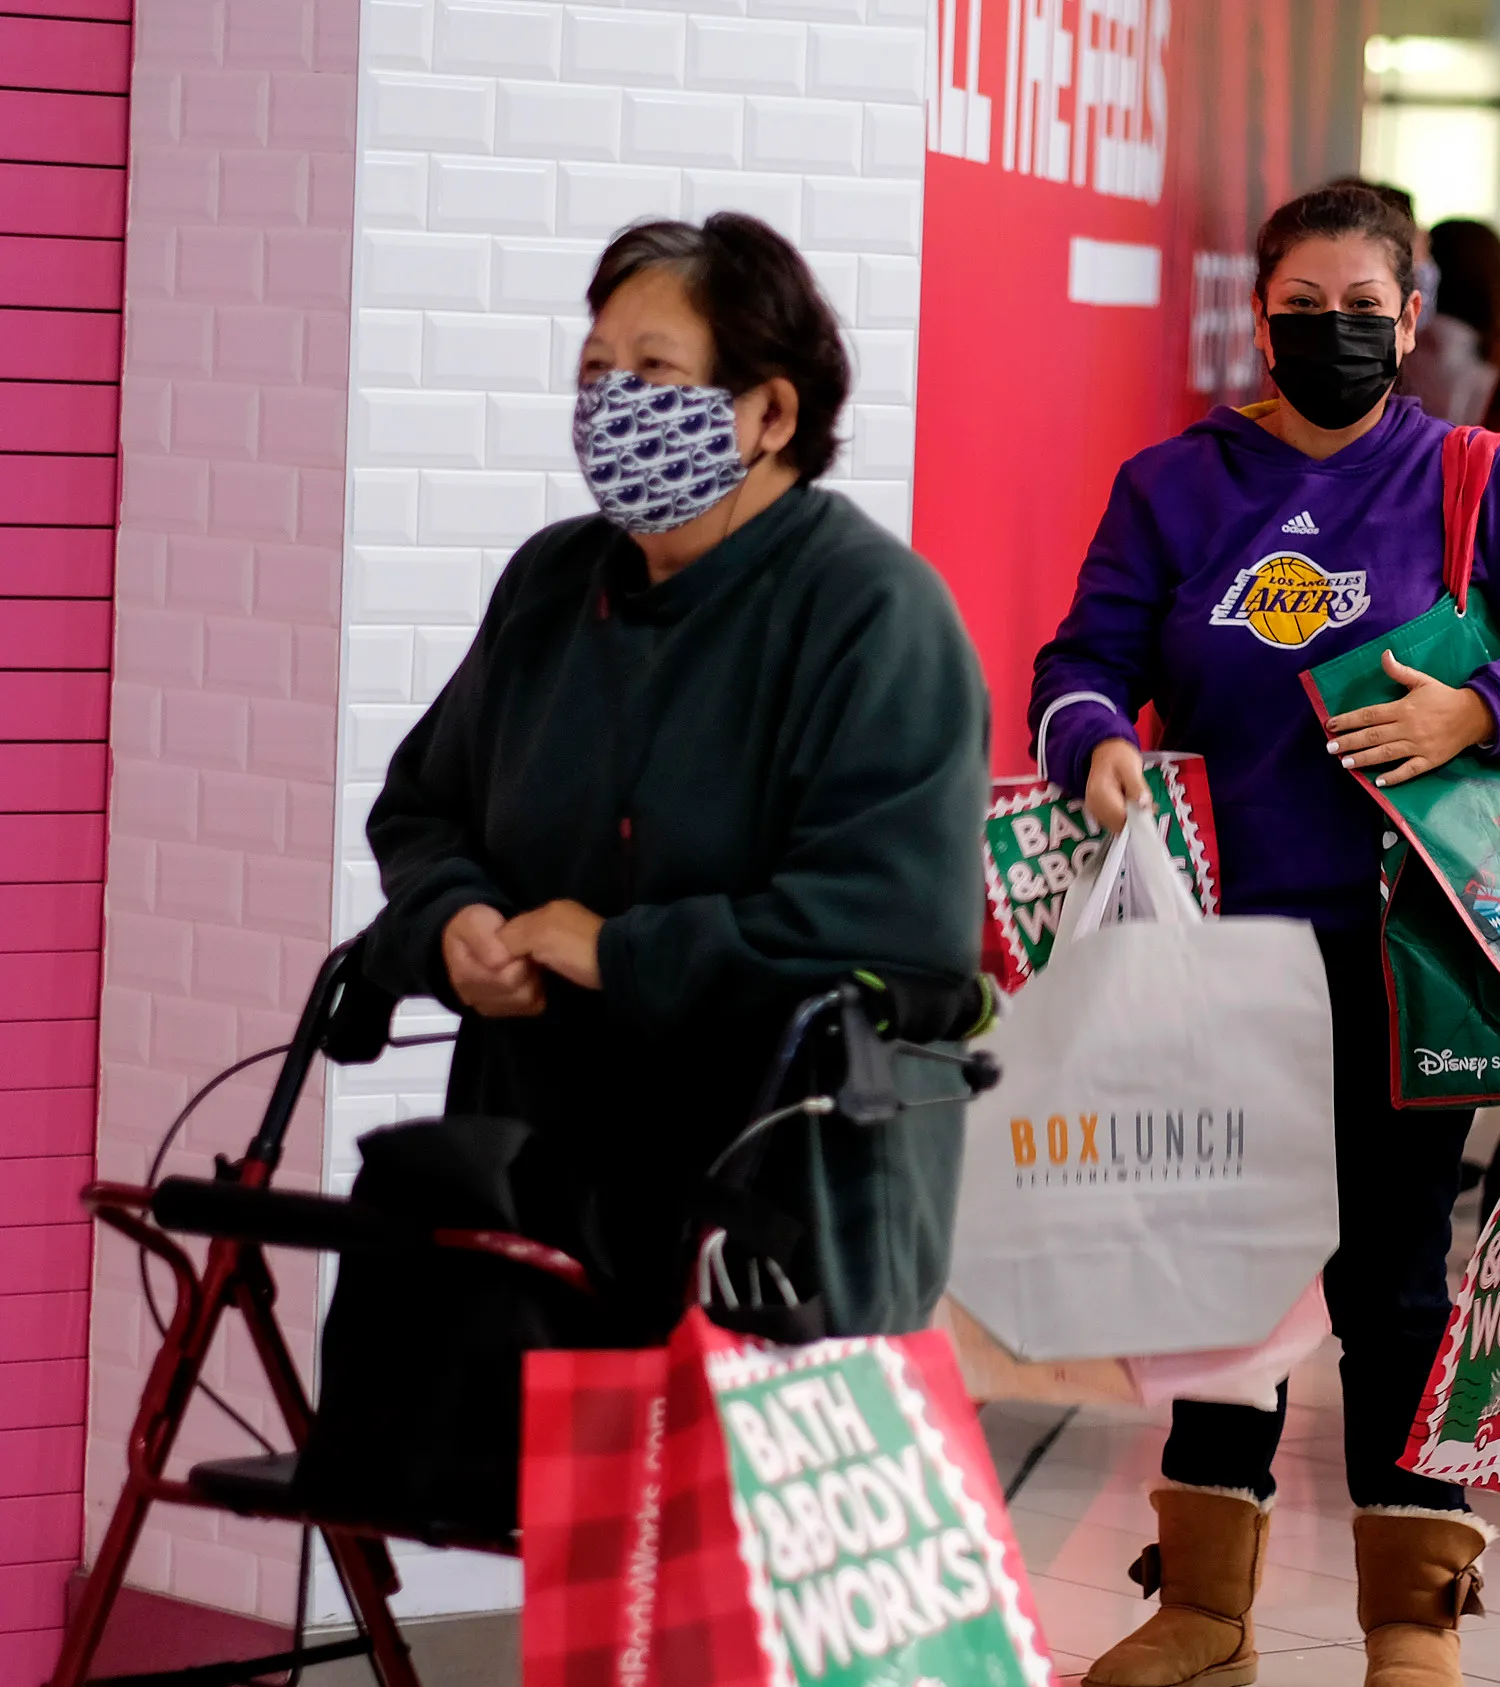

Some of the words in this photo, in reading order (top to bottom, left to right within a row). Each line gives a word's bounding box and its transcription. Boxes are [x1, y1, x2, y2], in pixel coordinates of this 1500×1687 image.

[1219, 574, 1364, 621] LAKERS
[1268, 576, 1294, 586] LOS
[1296, 576, 1362, 587] ANGELES
[1011, 800, 1101, 859] BAT
[723, 1370, 880, 1486] BATH
[772, 1526, 993, 1679] WORKS
